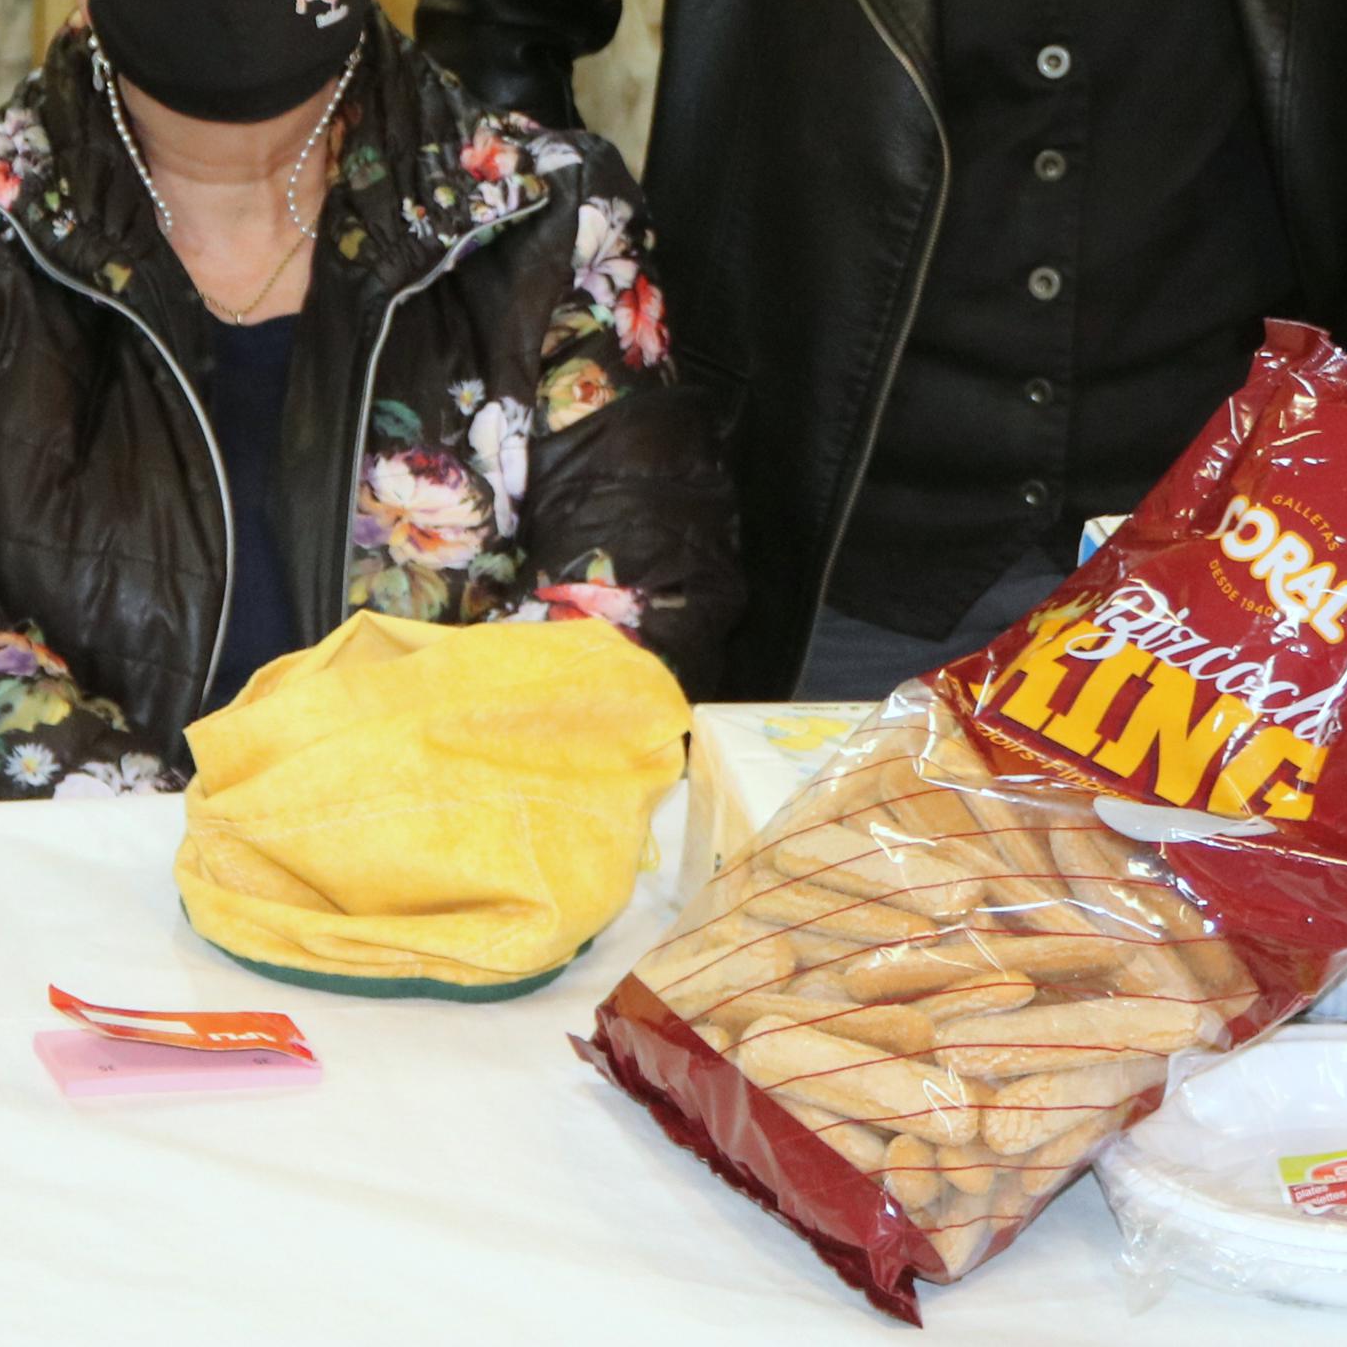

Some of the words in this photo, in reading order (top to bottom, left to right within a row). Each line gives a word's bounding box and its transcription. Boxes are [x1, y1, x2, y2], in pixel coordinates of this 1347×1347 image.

[1272, 494, 1341, 552] GALLETAS
[1209, 558, 1240, 602] DESDE
[1240, 597, 1275, 618] 1940
[968, 618, 1330, 822] KING
[1294, 1185, 1329, 1202] plates
